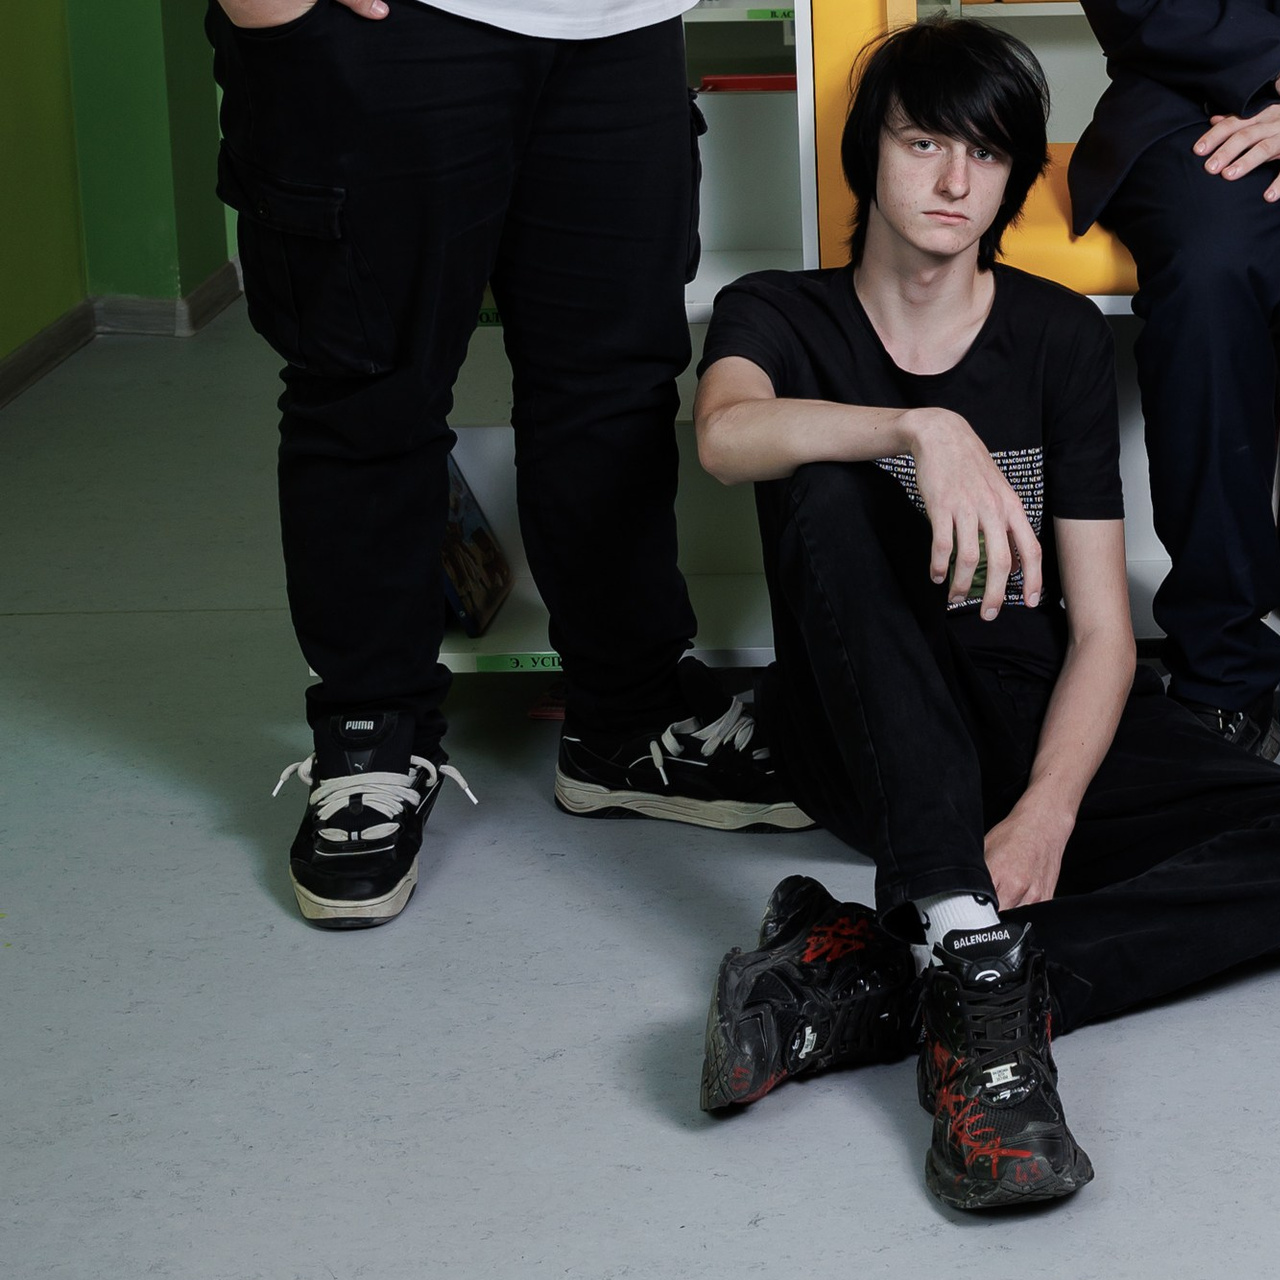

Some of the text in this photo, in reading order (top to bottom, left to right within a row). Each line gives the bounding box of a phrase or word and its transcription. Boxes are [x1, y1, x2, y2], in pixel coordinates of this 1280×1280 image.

[510, 657, 561, 668] Э. УСП
[345, 720, 374, 730] PUMA
[953, 929, 1011, 949] BALENCIAGA
